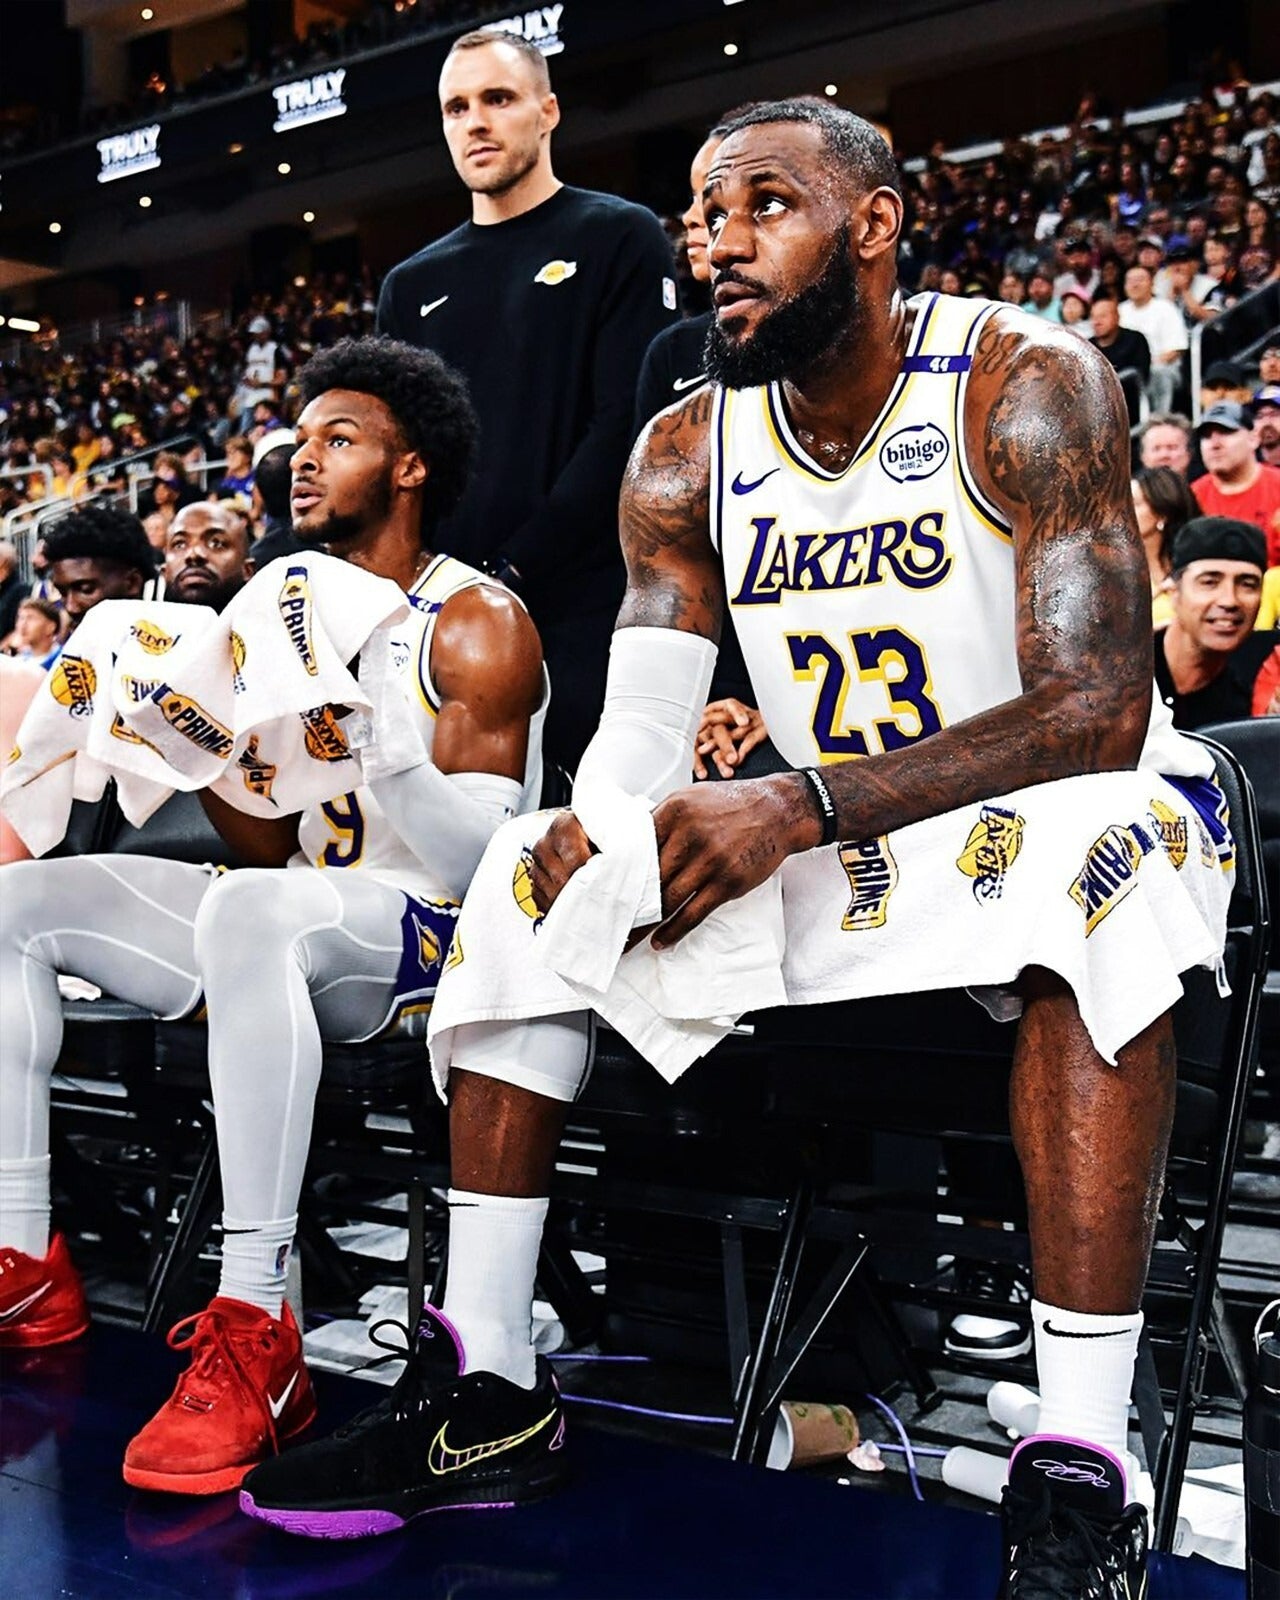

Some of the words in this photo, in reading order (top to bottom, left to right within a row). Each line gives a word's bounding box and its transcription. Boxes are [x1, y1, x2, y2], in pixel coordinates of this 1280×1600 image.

[273, 68, 346, 112] TRULY
[97, 124, 160, 165] TRULY
[886, 439, 945, 463] bibigo
[730, 510, 955, 607] LAKERS
[281, 598, 312, 666] PRIME
[171, 706, 234, 752] PRIME
[783, 625, 945, 765] 23
[318, 790, 365, 868] 9
[840, 839, 890, 917] PRIME
